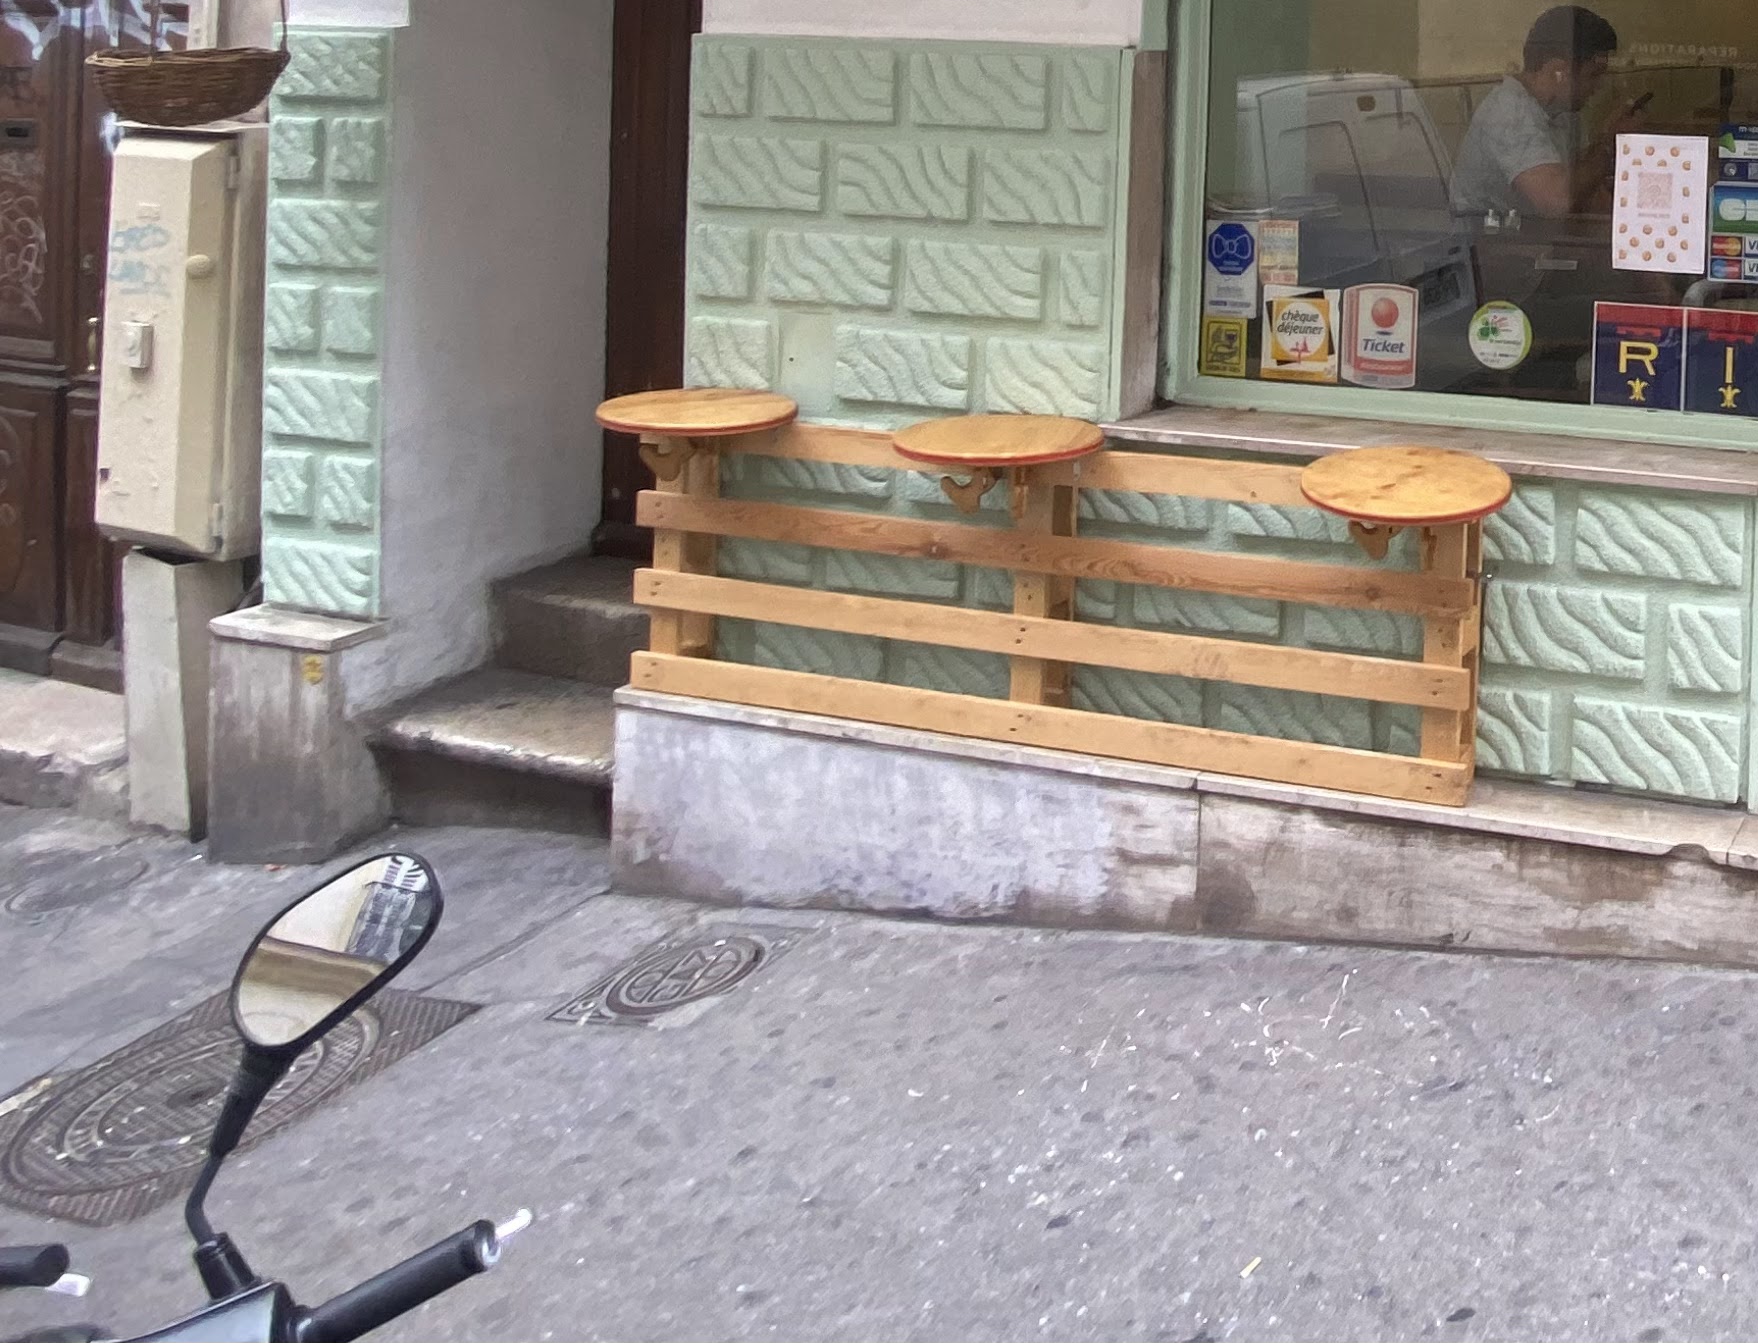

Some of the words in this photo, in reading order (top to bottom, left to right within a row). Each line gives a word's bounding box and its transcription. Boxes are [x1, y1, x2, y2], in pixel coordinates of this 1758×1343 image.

[1281, 310, 1319, 327] chèque
[1277, 319, 1324, 336] déjeuner
[1362, 338, 1405, 354] Ticket
[1618, 340, 1659, 376] R
